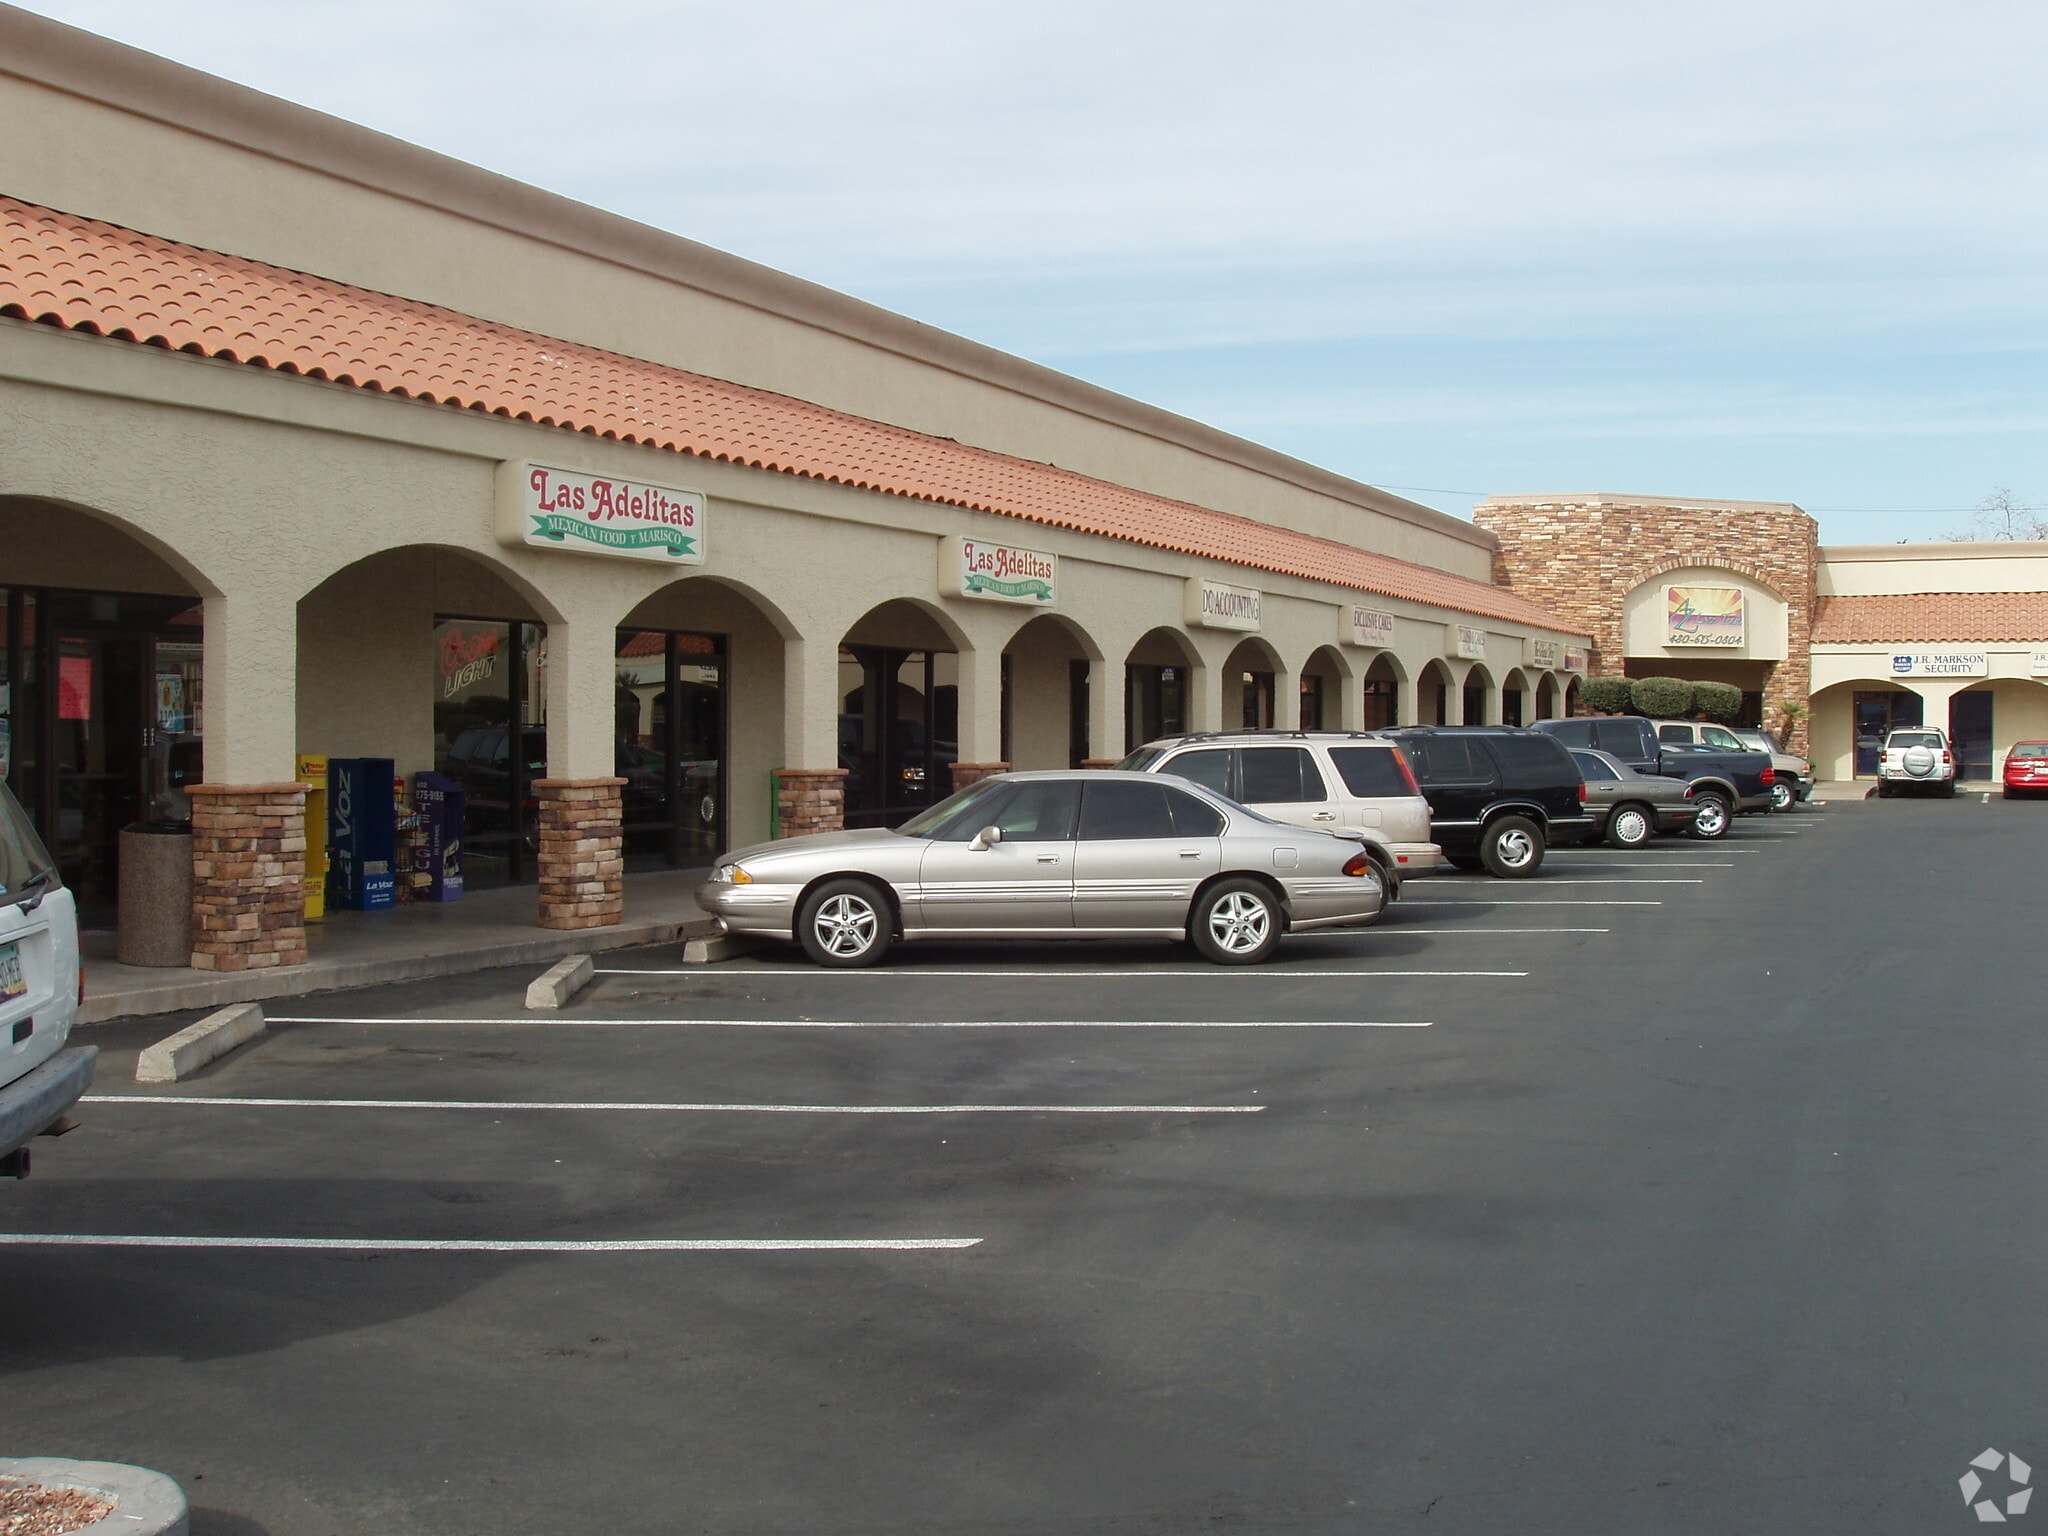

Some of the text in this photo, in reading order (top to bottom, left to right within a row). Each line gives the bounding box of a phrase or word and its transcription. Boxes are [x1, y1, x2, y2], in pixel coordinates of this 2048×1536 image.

[530, 469, 694, 527] Las Adelitas
[548, 517, 598, 540] MEXICAN
[600, 530, 626, 545] FOOD
[638, 529, 681, 545] MARISCO
[964, 542, 1052, 579] Las Adelitas
[1214, 591, 1259, 621] ACCOUNTING
[1924, 664, 1974, 673] SECURITY
[1934, 655, 1984, 663] MARKSON
[444, 656, 497, 698] LIGHT
[335, 767, 351, 837] Voz
[367, 880, 394, 890] La Voz
